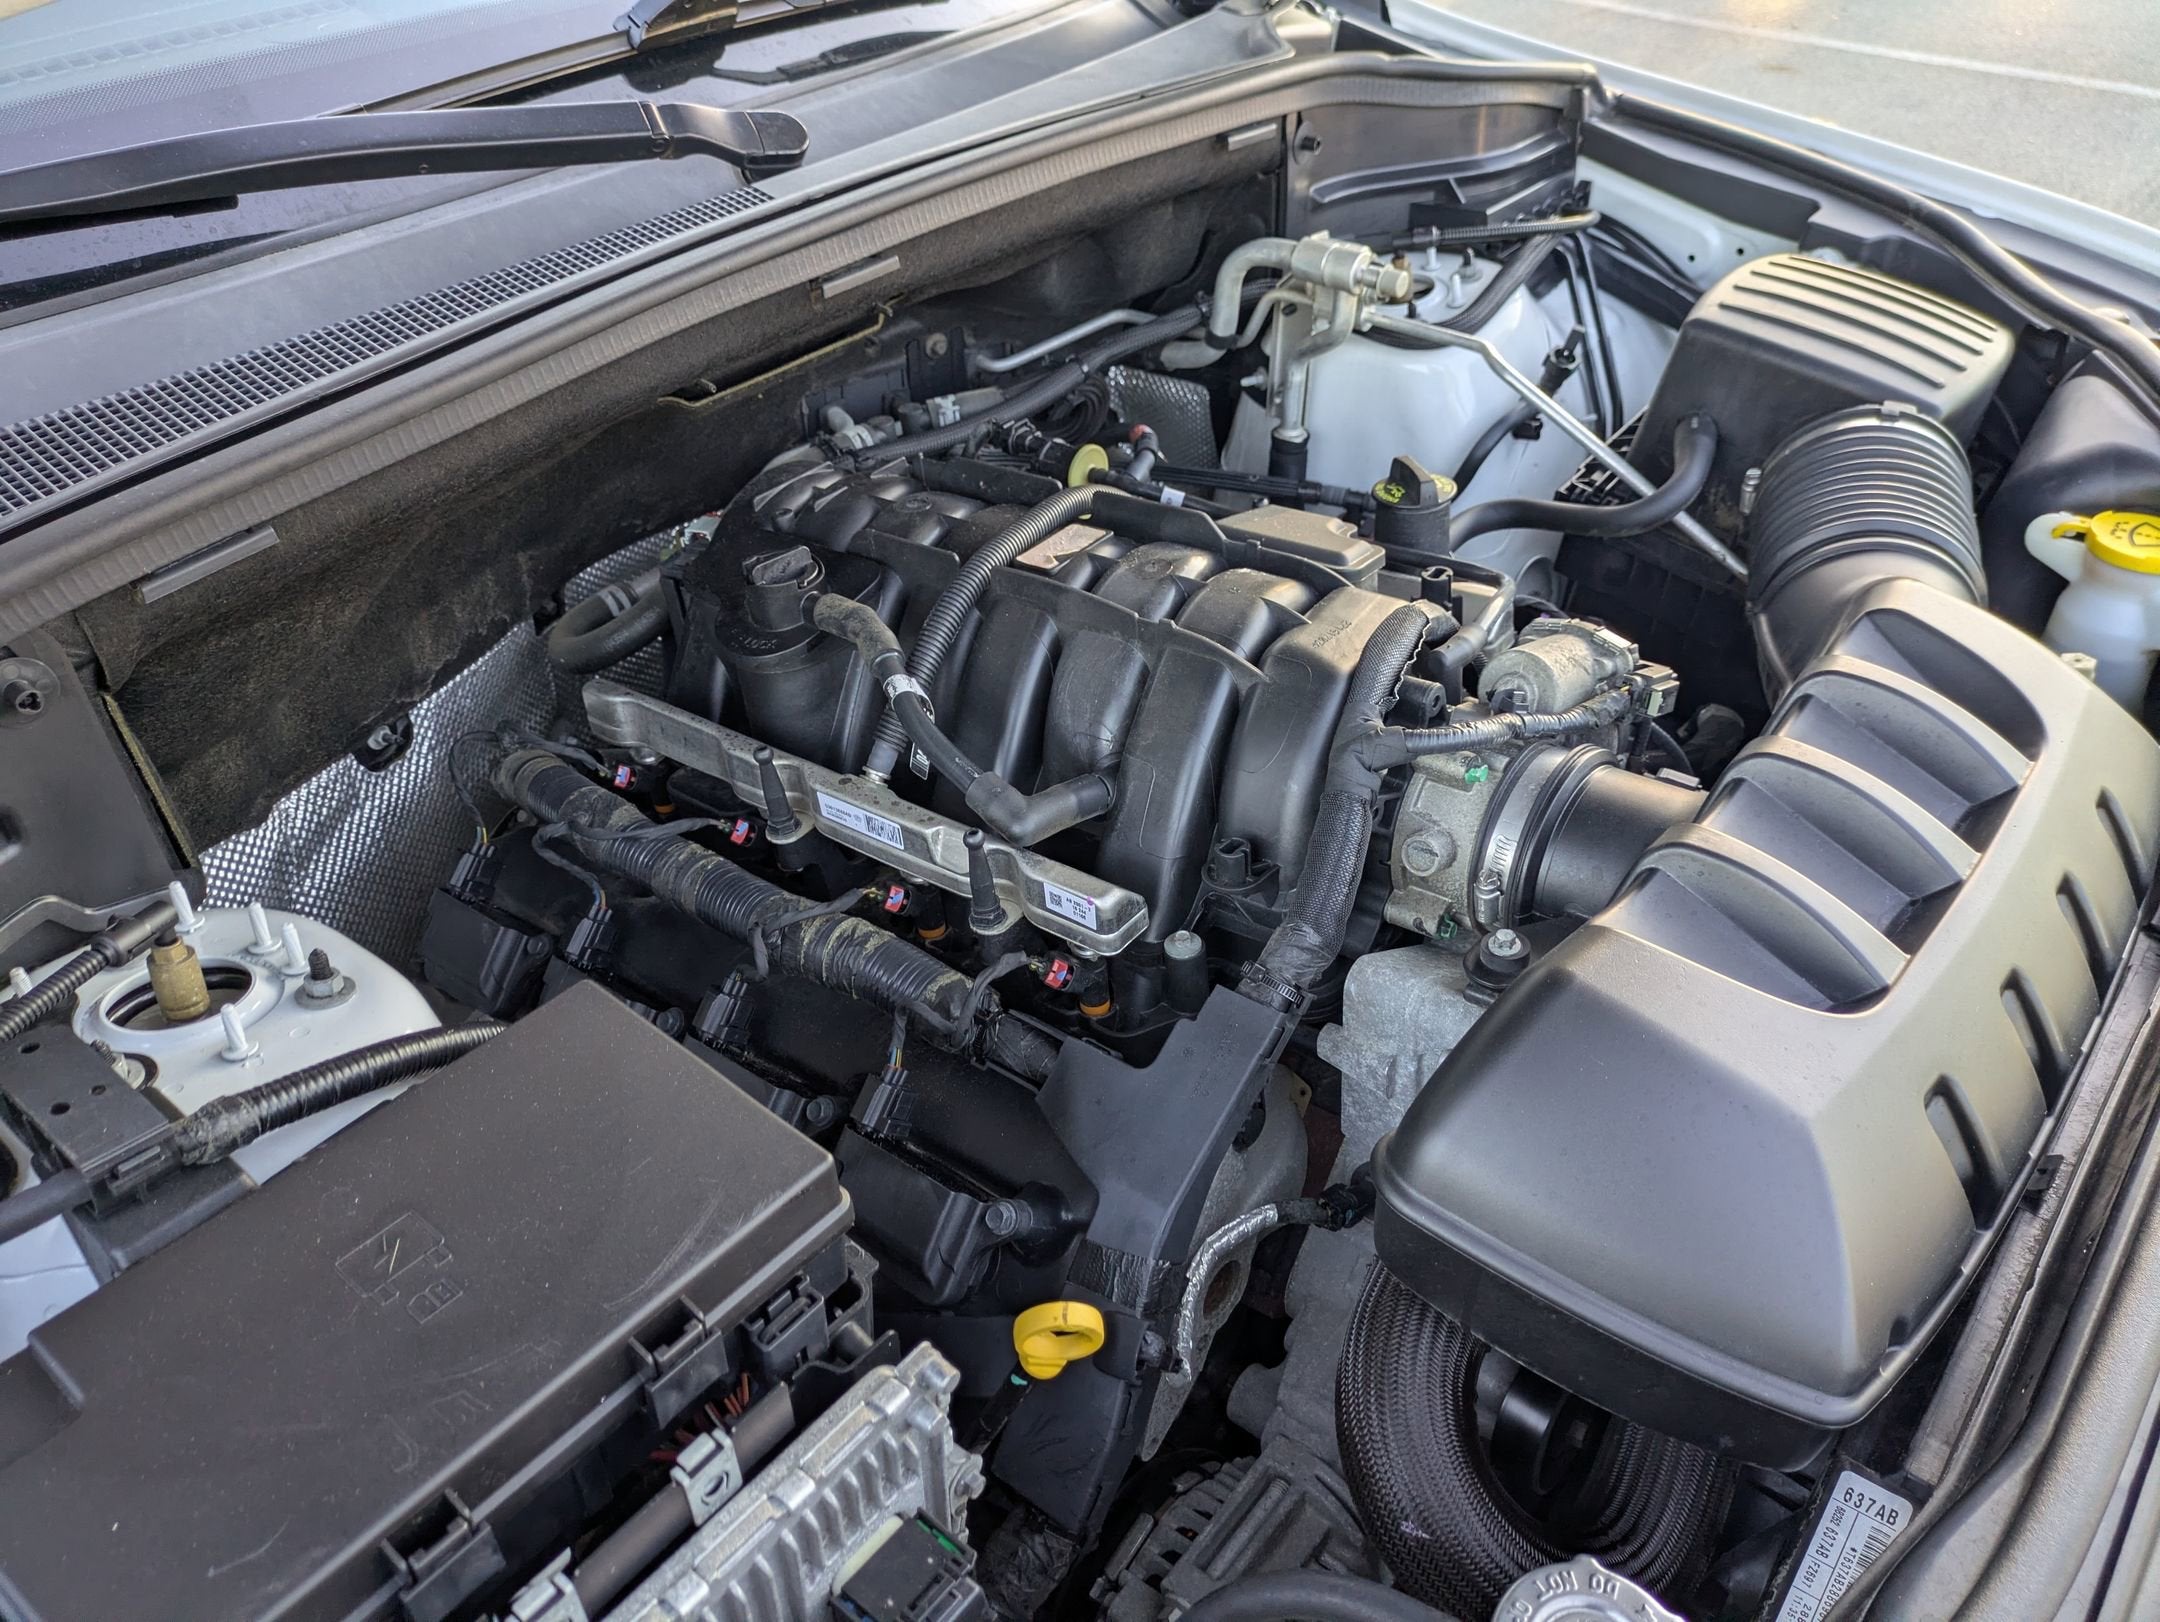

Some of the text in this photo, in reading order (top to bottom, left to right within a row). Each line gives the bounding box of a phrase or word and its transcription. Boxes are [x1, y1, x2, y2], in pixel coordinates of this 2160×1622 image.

[1843, 1487, 1899, 1526] 637AB
[1815, 1526, 1839, 1559] 637AB
[1536, 1570, 1578, 1601] NOT
[1590, 1574, 1620, 1600] DO
[1801, 1560, 1821, 1588] FZ697
